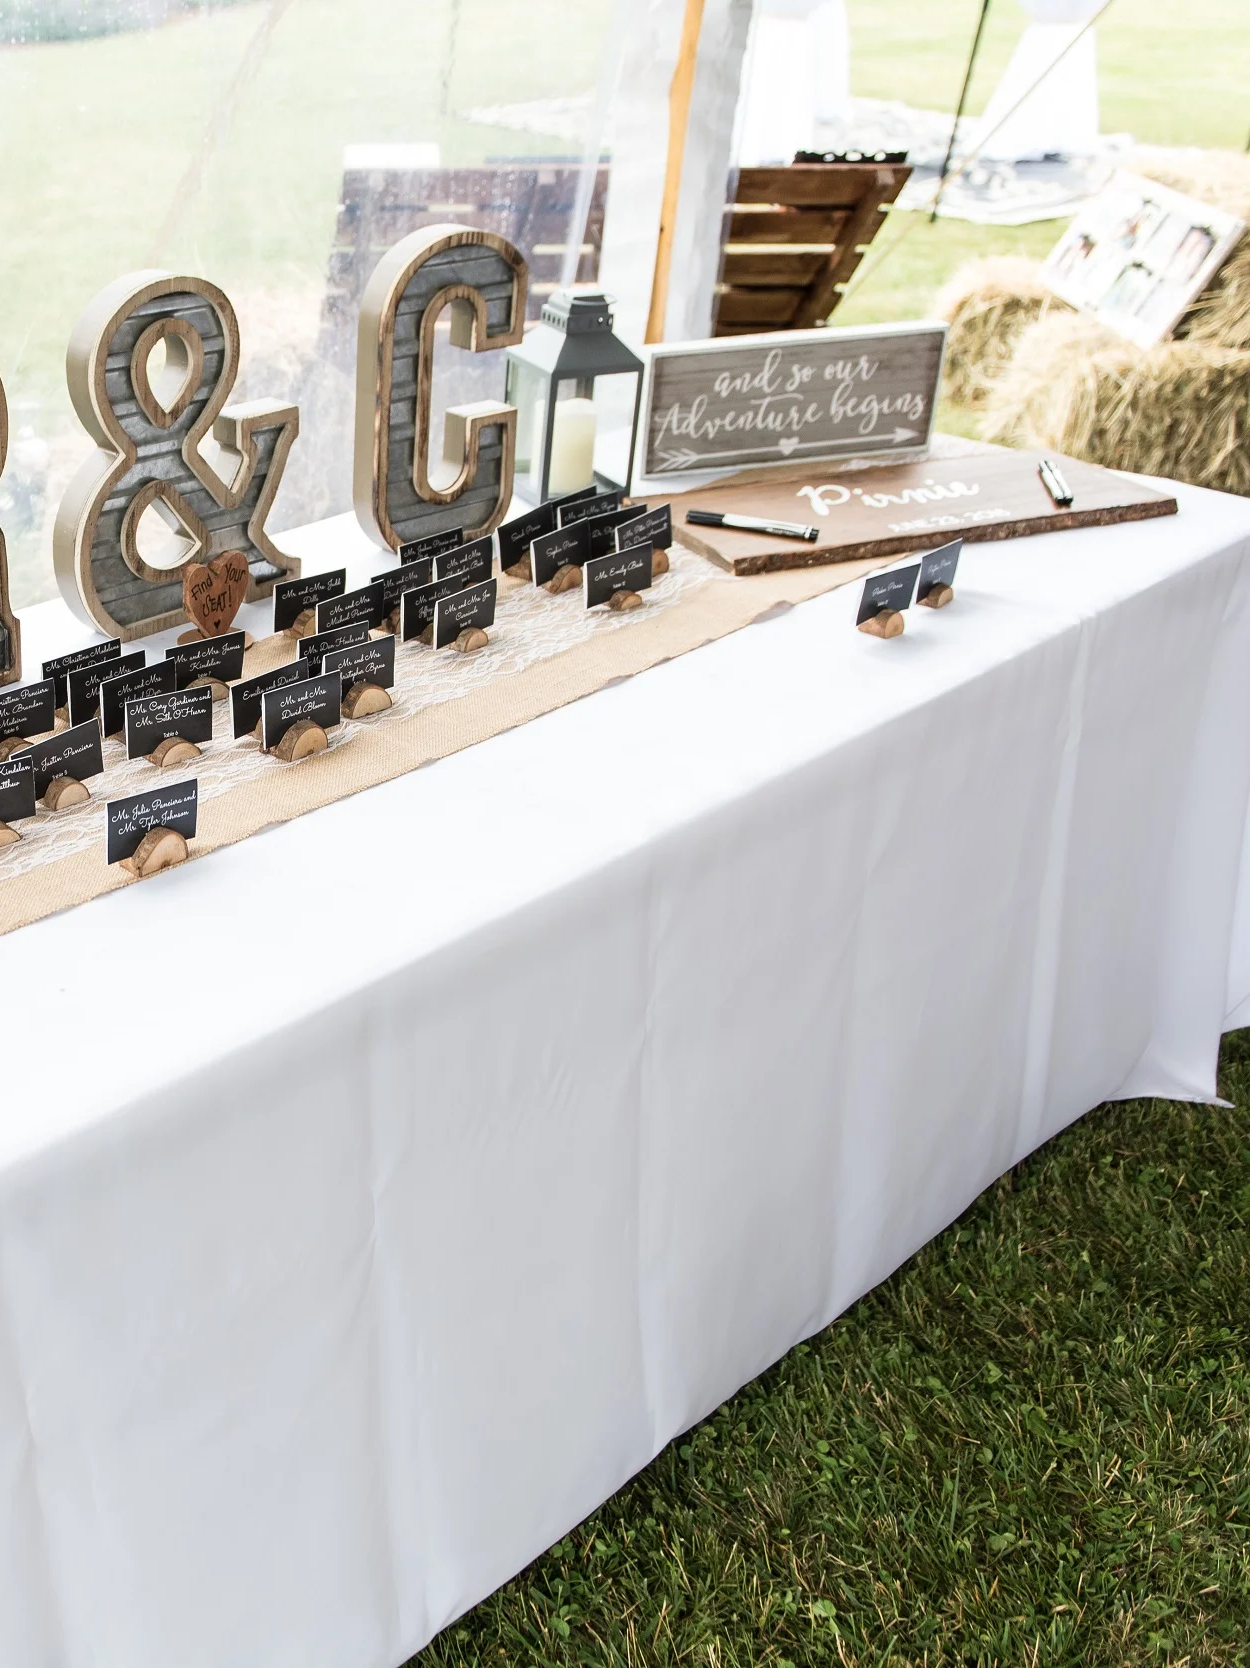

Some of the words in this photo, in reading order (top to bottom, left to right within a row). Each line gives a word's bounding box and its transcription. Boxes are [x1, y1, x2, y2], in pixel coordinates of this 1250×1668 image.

[713, 349, 783, 398] and
[784, 362, 817, 393] so
[822, 354, 880, 382] our
[653, 392, 824, 450] Adventure
[828, 380, 926, 435] begins
[53, 269, 302, 641] &
[353, 224, 529, 555] G
[796, 479, 980, 517] Pirnie
[190, 573, 214, 601] Find
[224, 562, 247, 585] Your
[297, 585, 309, 596] and
[201, 584, 233, 618] SEAT!
[344, 599, 355, 610] and
[457, 598, 467, 609] and
[354, 631, 366, 642] and
[189, 650, 201, 661] and
[201, 645, 221, 657] Mrs.
[337, 658, 354, 670] Mr.
[353, 653, 365, 665] and
[364, 649, 382, 661] Mrs.
[189, 658, 222, 672] Kindelan
[85, 674, 101, 687] Mr.
[102, 669, 114, 681] and
[117, 683, 133, 696] Mr.
[133, 679, 146, 691] and
[145, 673, 163, 686] Mrs.
[265, 680, 277, 692] and
[11, 700, 44, 714] Brandon
[129, 703, 148, 716] Ms.
[148, 701, 169, 714] Cory
[198, 690, 212, 701] and
[279, 694, 296, 708] Mr.
[297, 690, 309, 702] and
[308, 685, 327, 699] Mrs.
[135, 717, 153, 728] Mr.
[154, 712, 173, 724] Seth
[281, 705, 302, 720] David
[302, 700, 327, 713] Bloom
[112, 809, 130, 823] Ms.
[132, 804, 150, 820] Julia
[151, 799, 182, 811] Panciera
[182, 790, 196, 800] and
[119, 822, 136, 835] Mr.
[139, 817, 160, 831] Tyler
[161, 810, 189, 825] Johnson
